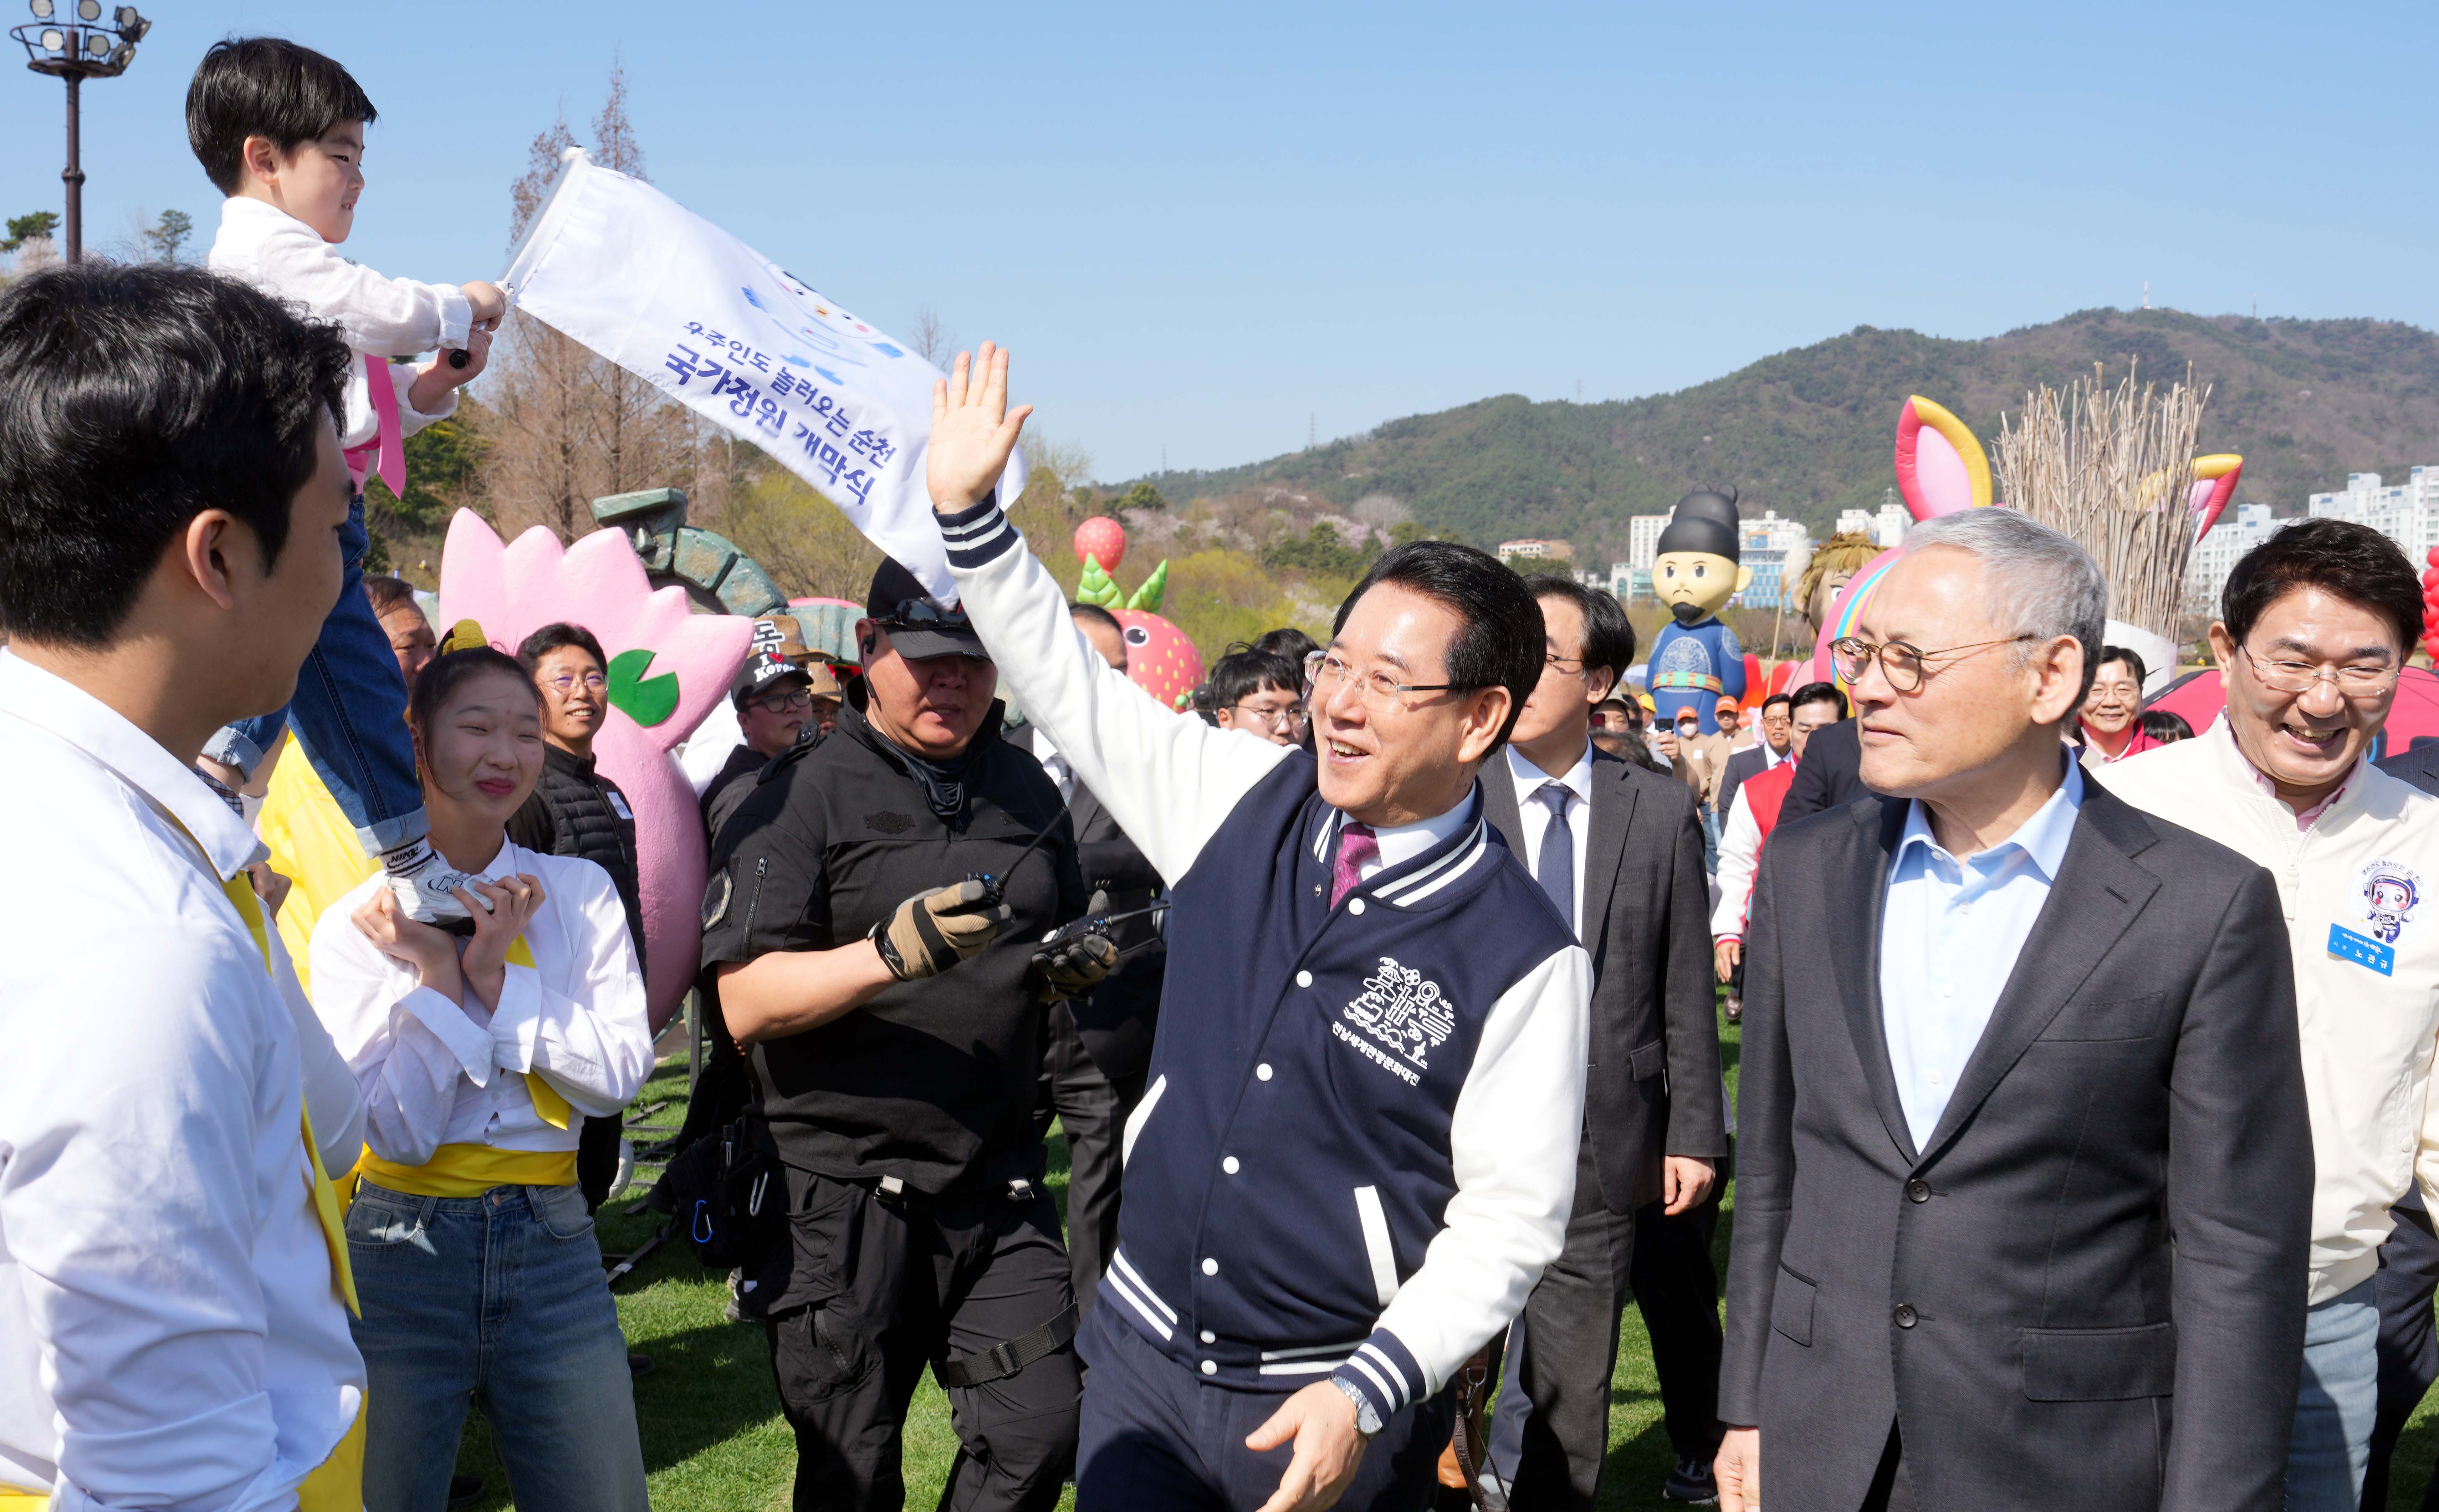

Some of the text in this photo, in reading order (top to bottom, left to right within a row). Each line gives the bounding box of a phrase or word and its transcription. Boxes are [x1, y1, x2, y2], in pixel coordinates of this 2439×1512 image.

[665, 343, 875, 505] 국가정원 개막식
[684, 321, 897, 469] 우주인도 놀러오는 순천
[760, 654, 769, 666] I
[391, 846, 419, 862] NIKE
